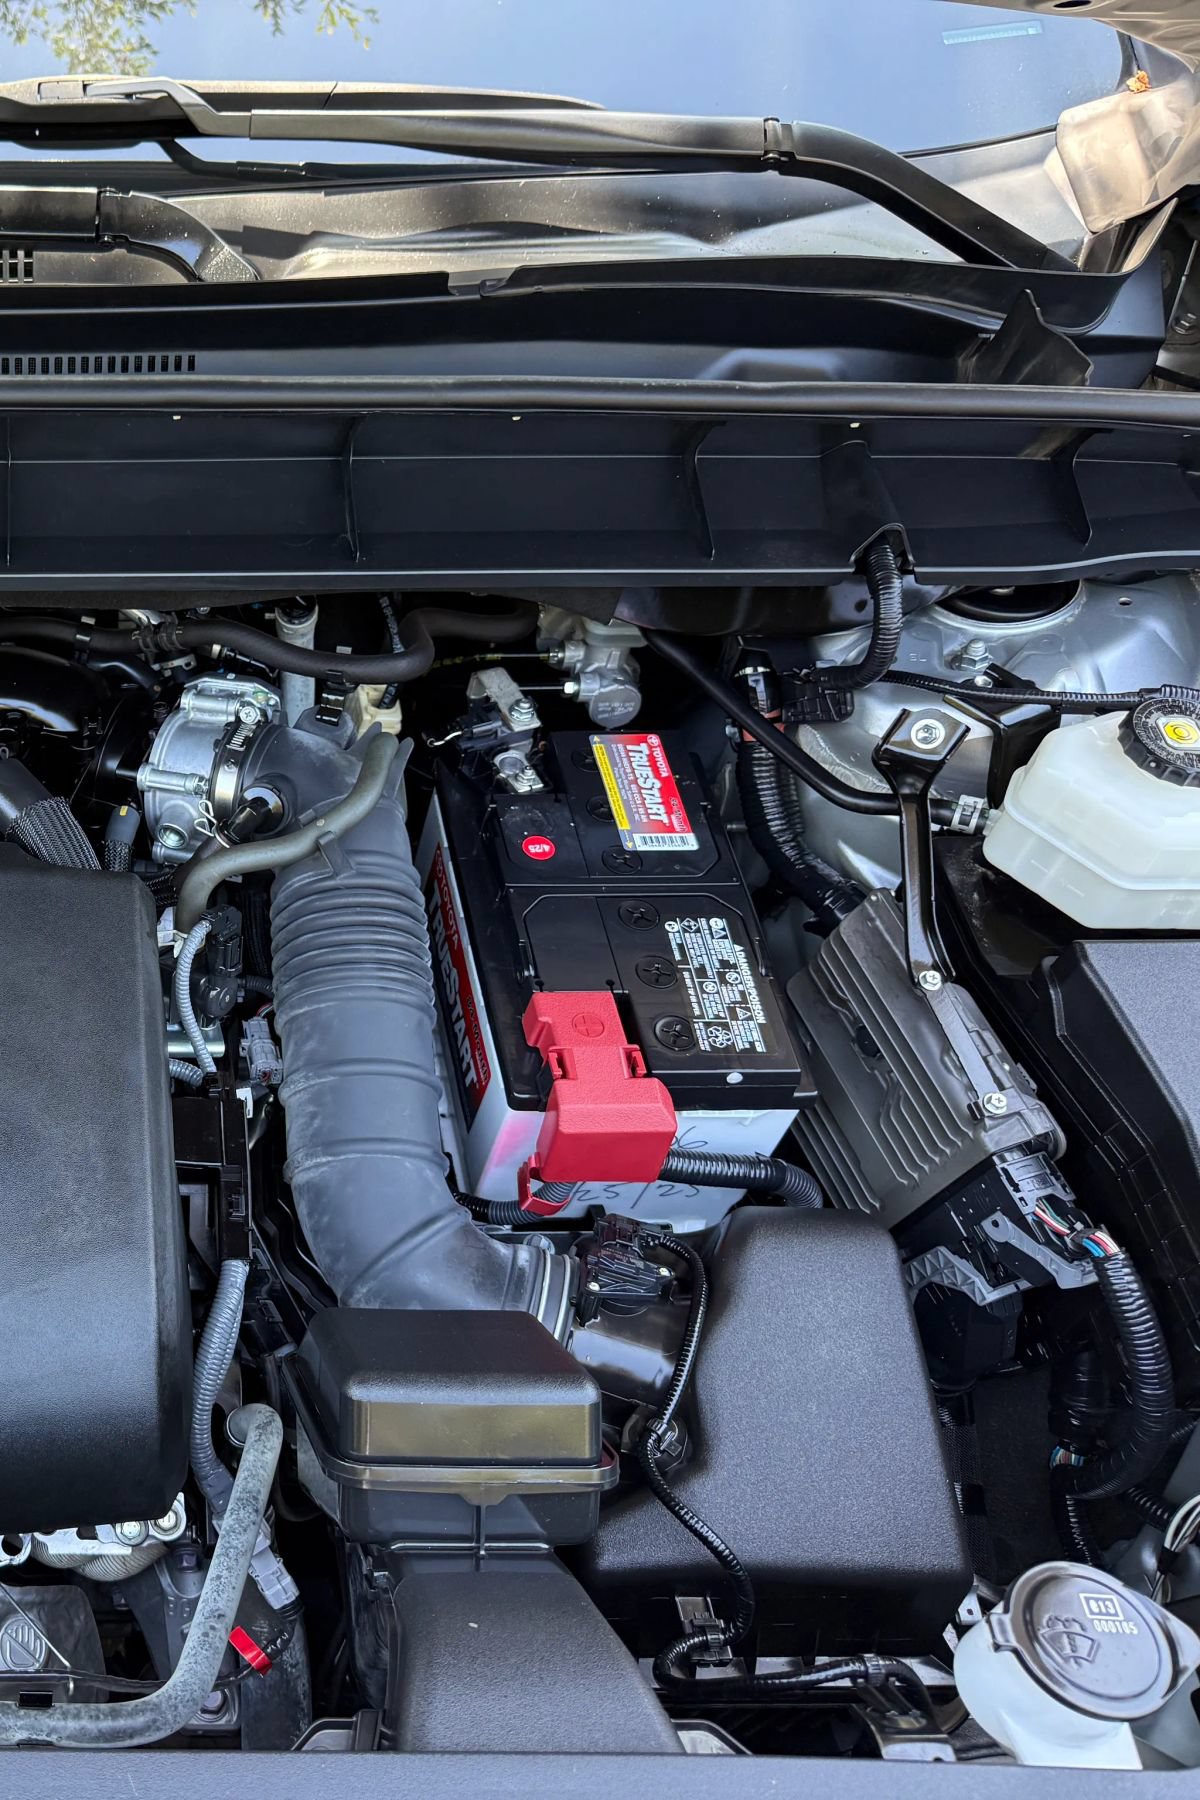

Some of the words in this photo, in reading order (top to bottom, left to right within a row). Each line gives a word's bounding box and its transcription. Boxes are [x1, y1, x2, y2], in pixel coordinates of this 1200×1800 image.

[626, 743, 669, 824] TRUESTART
[651, 747, 669, 777] TOYOTA
[440, 874, 459, 950] TOYOTA
[737, 952, 766, 1023] DANGER/POISON
